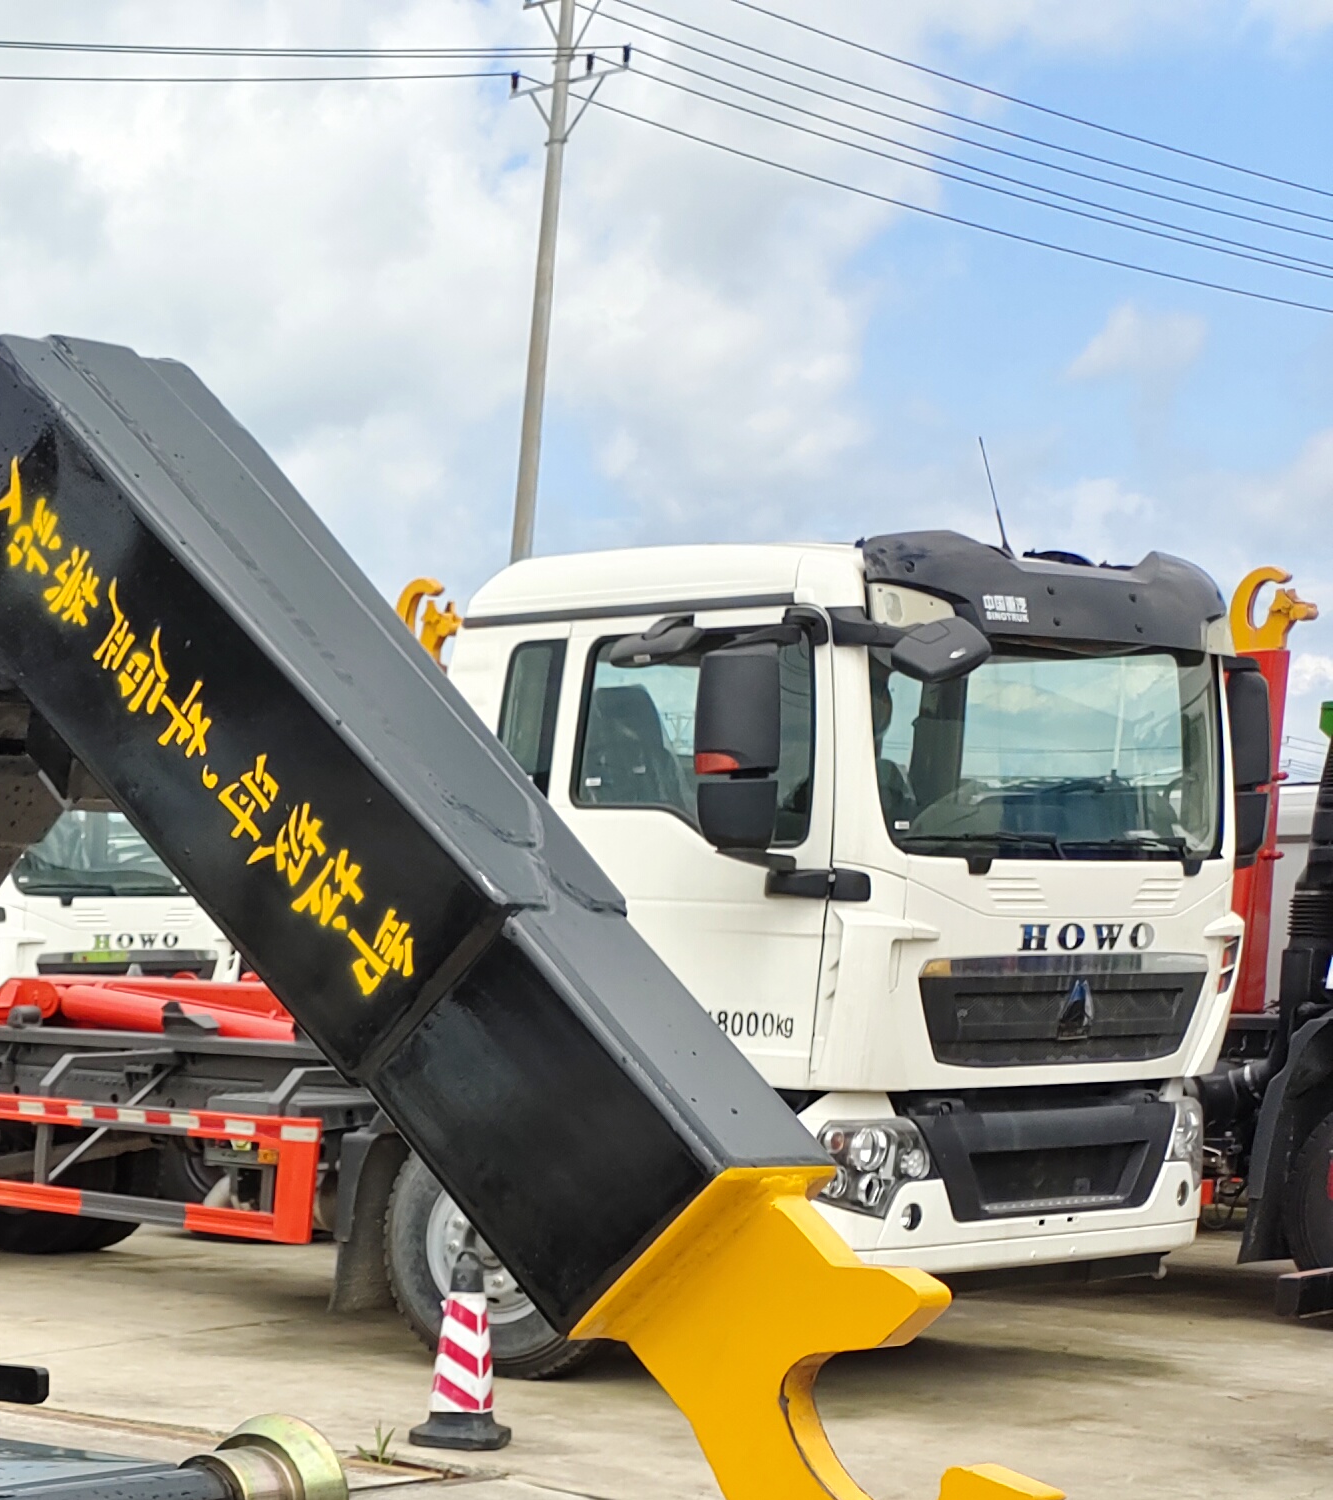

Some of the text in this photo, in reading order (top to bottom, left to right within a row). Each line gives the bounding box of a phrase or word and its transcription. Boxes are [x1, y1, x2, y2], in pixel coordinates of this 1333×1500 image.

[986, 611, 1030, 623] SINOTRUK
[92, 932, 179, 951] HOWO
[1017, 922, 1155, 951] HOWO
[709, 1009, 794, 1039] 8000kg
